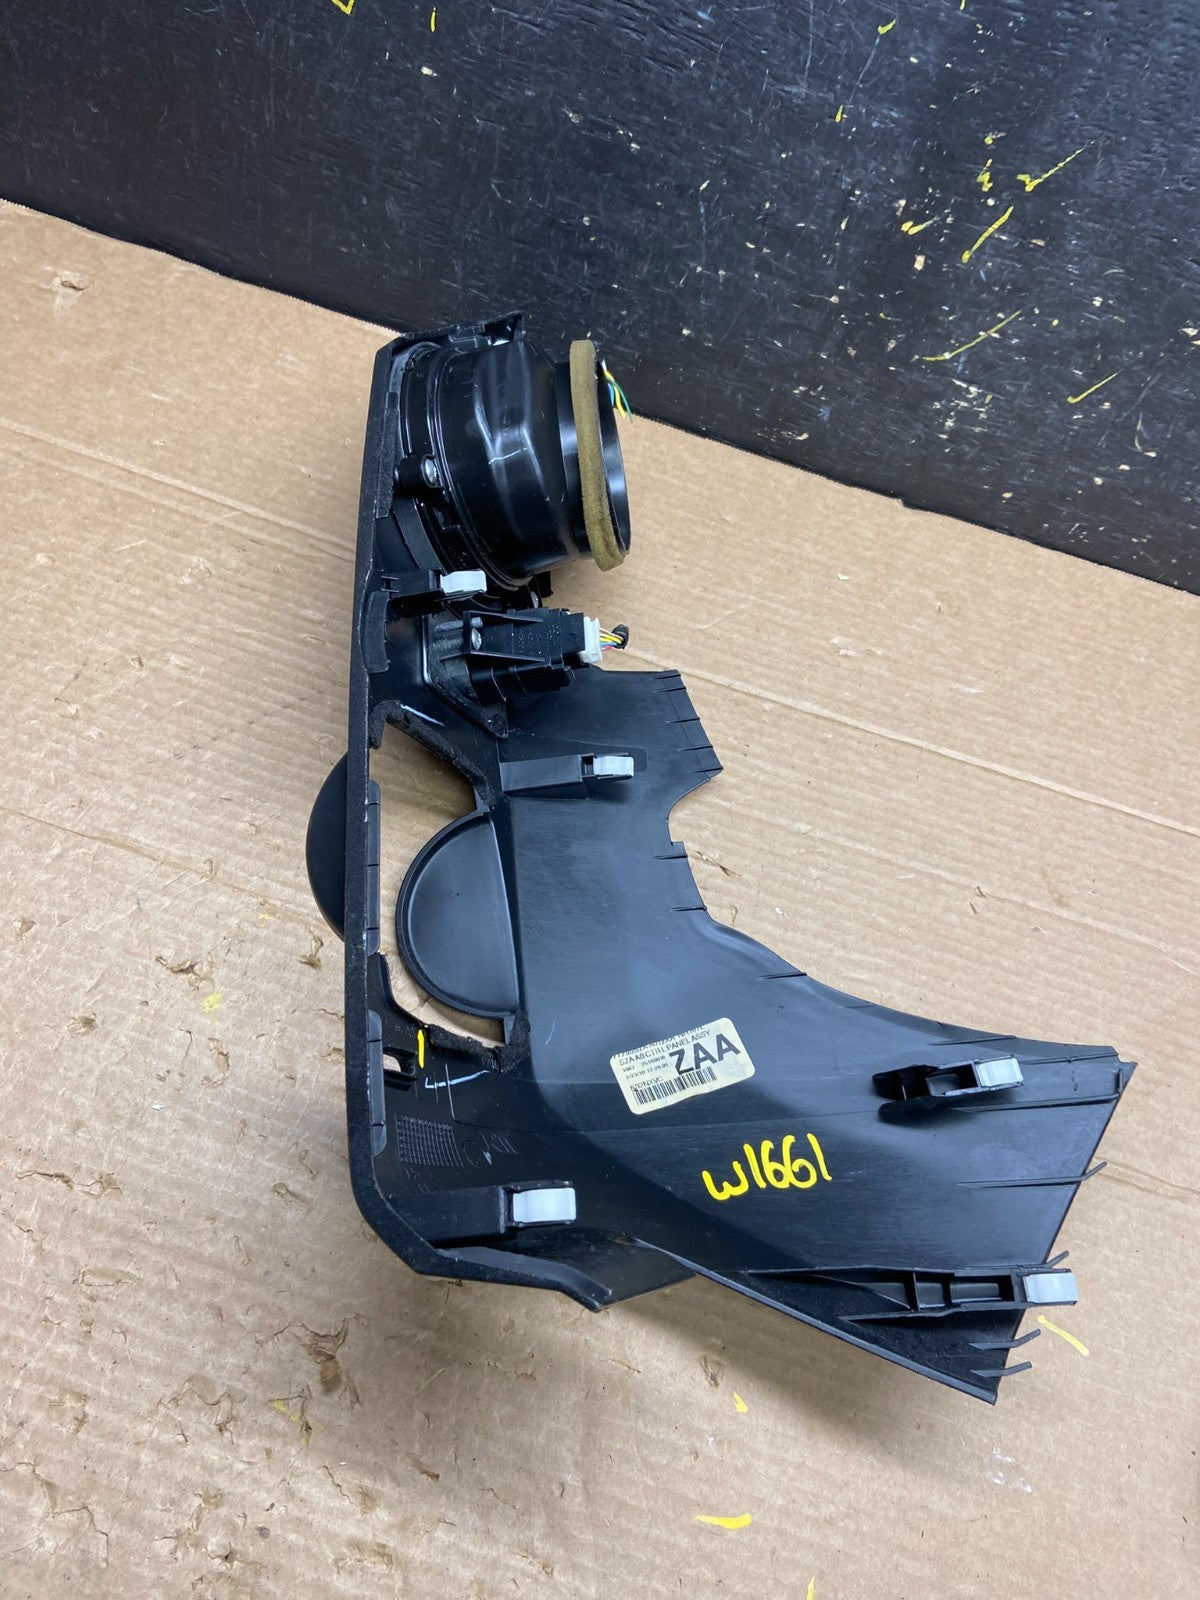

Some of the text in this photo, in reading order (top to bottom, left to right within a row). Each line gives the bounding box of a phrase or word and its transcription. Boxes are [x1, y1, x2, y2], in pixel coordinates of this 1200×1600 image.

[666, 1037, 691, 1050] PANEL
[691, 1029, 711, 1041] ASSY
[668, 1032, 741, 1075] ZAA
